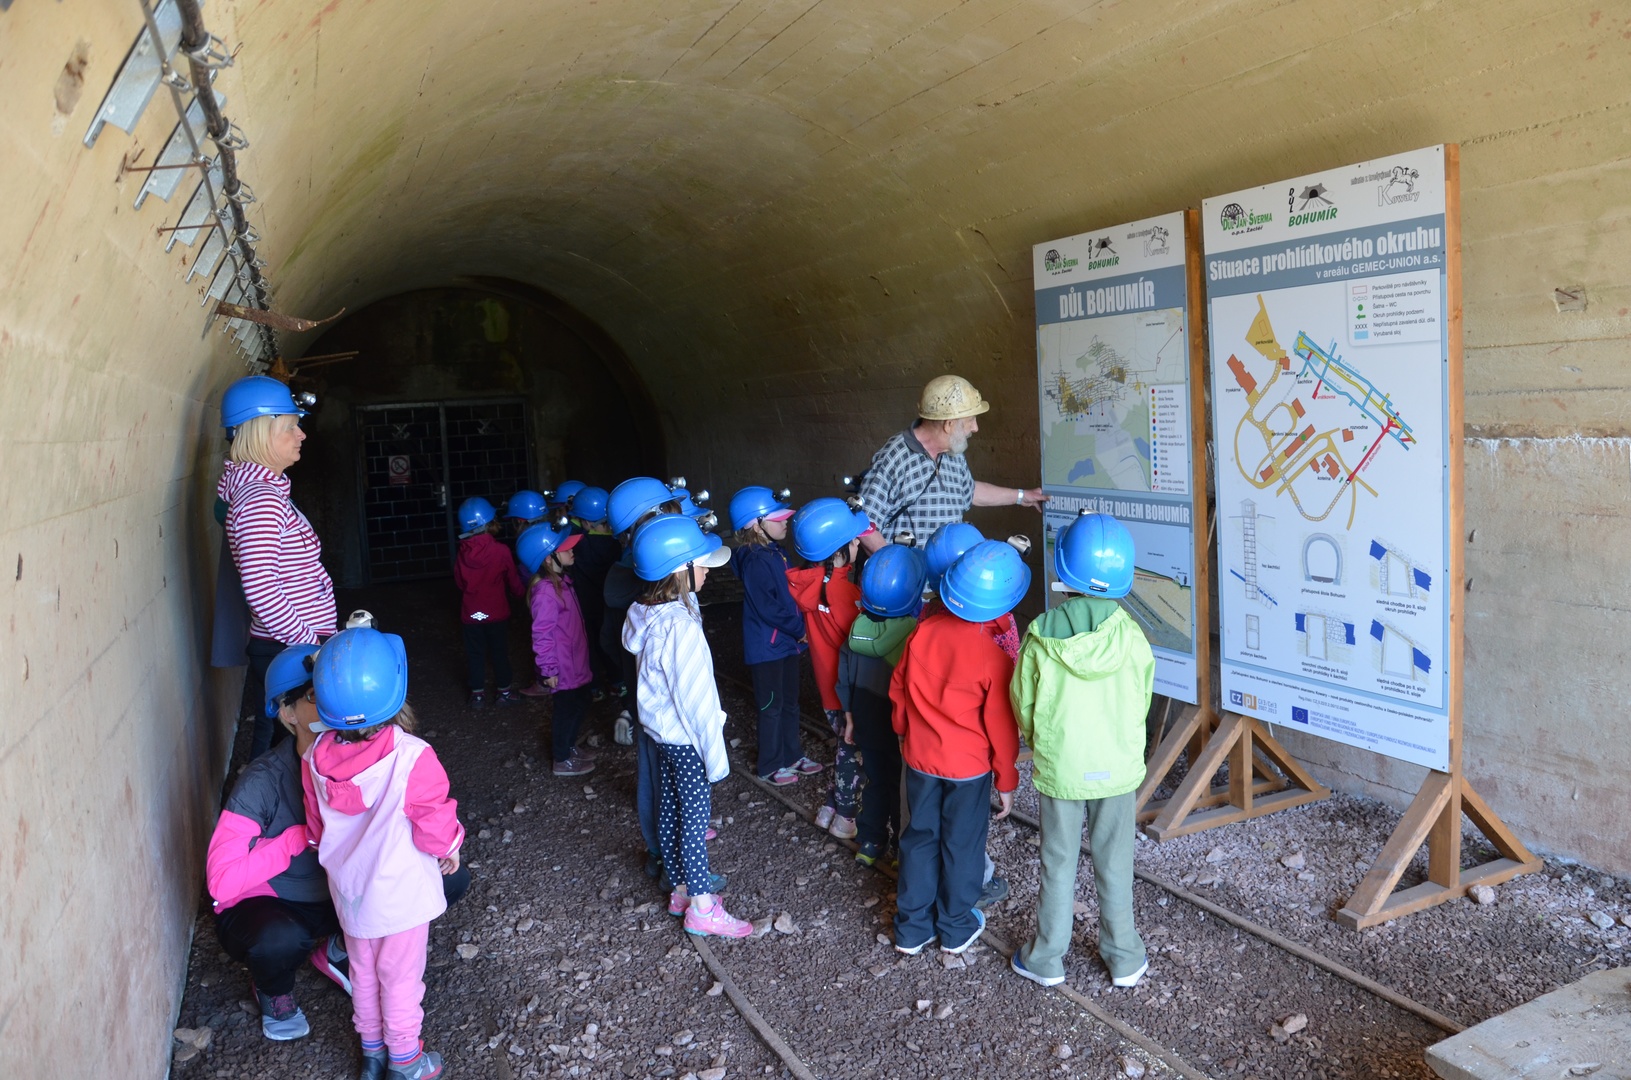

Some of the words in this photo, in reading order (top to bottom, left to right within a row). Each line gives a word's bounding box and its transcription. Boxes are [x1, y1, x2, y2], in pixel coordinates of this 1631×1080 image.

[1378, 184, 1420, 207] Kowary
[1288, 206, 1338, 228] BOHUMÍR
[1088, 255, 1120, 270] BOHUMÍR
[1210, 257, 1260, 281] Situace
[1262, 237, 1373, 276] prohlídkového
[1376, 226, 1440, 256] okruhu
[1316, 271, 1322, 279] v
[1323, 265, 1350, 278] areálu
[1352, 254, 1420, 274] GEMEC-UNION
[1423, 254, 1441, 264] a.s.
[1059, 286, 1084, 319] DŮL
[1086, 276, 1155, 316] BOHUMÍR
[1045, 496, 1098, 512] SCHEMATICKÝ
[1098, 497, 1114, 515] ŘEZ
[1114, 501, 1144, 519] DOLEM
[1145, 504, 1190, 524] BOHUMÍR
